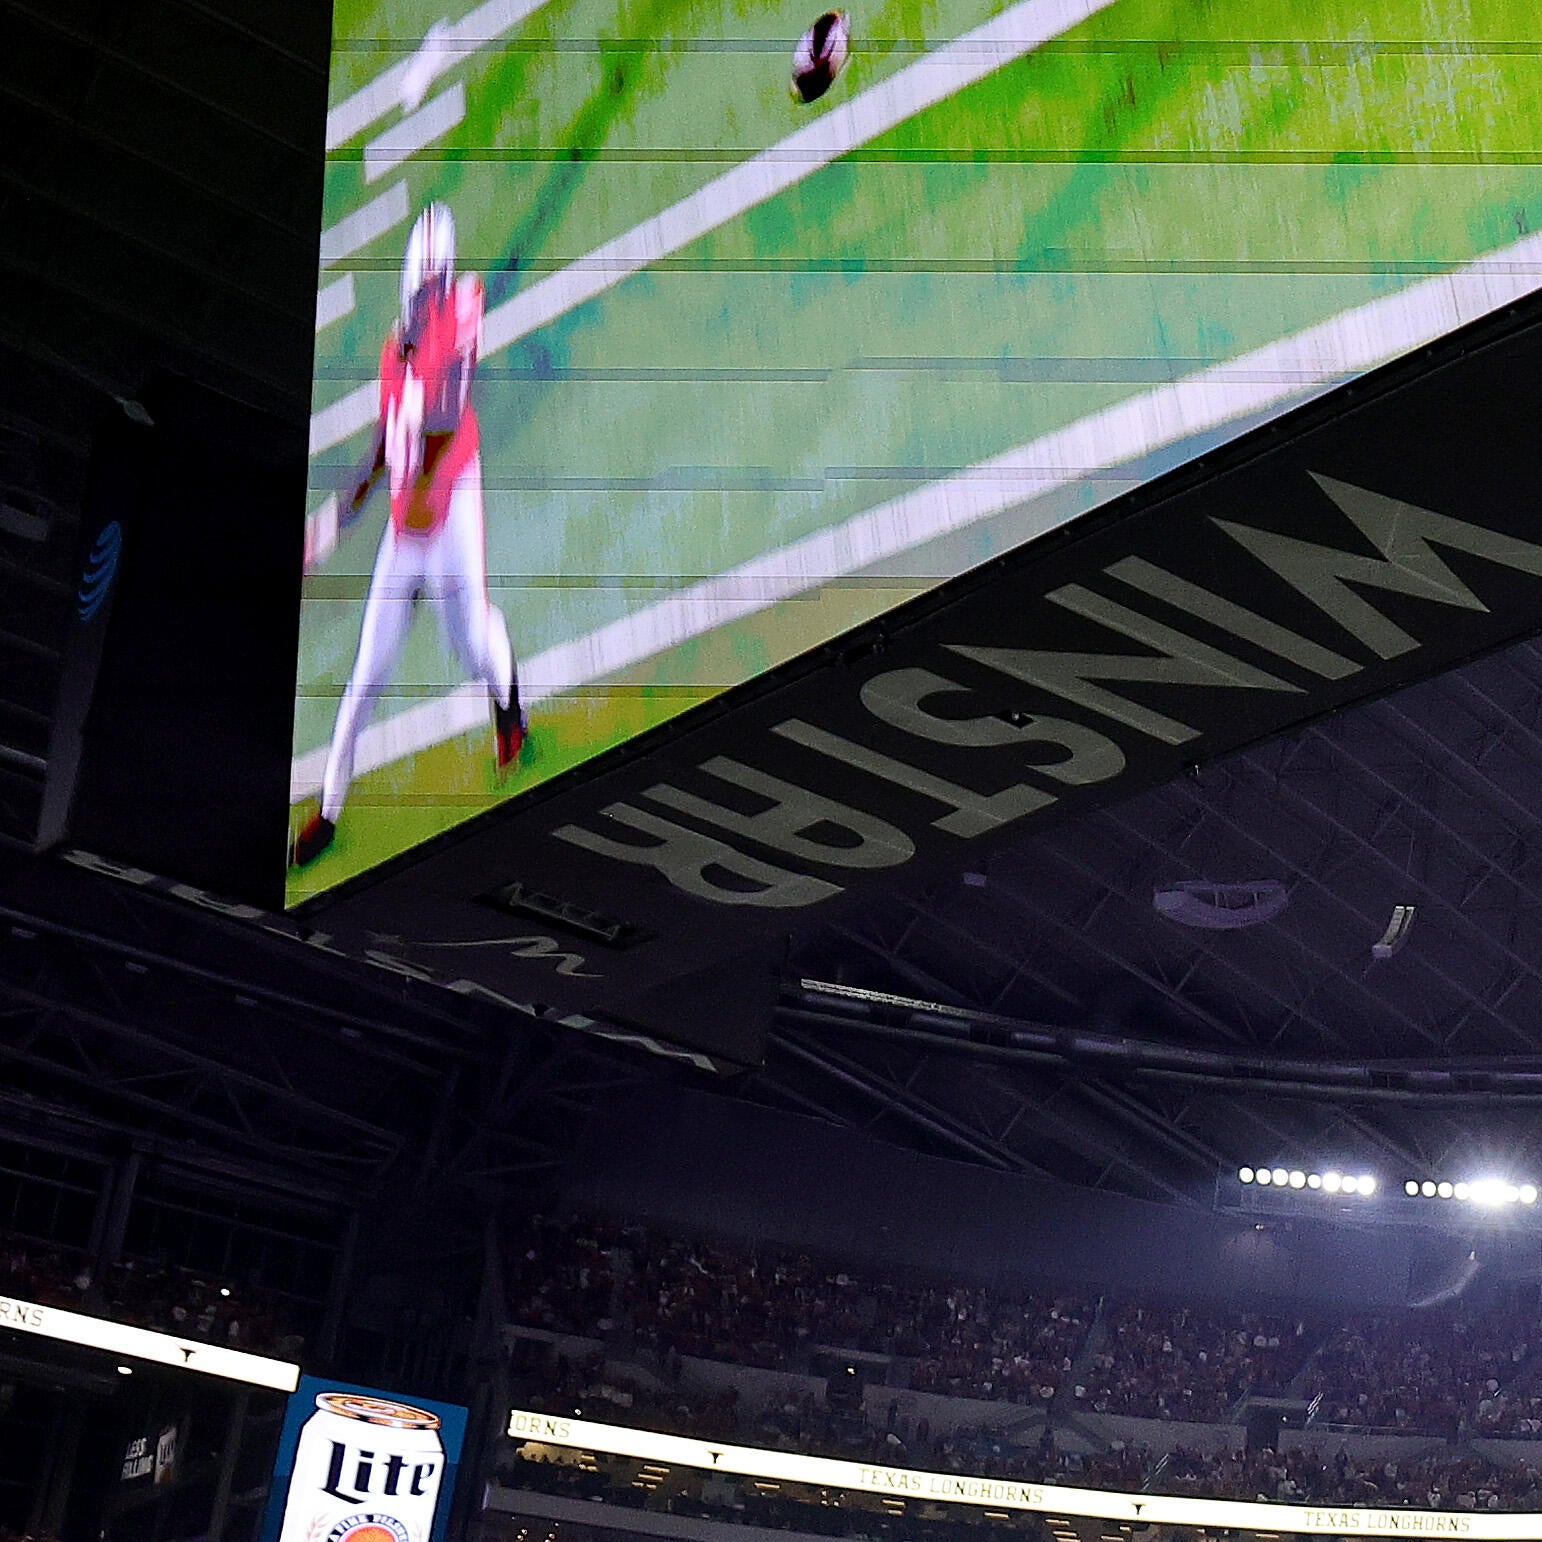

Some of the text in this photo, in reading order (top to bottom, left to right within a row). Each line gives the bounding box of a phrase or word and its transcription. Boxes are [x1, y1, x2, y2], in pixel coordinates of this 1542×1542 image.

[318, 1438, 435, 1505] Lite
[859, 1467, 1044, 1504] TEXAS LONGHORNS
[1303, 1511, 1471, 1532] TEXAS LONGHORNS
